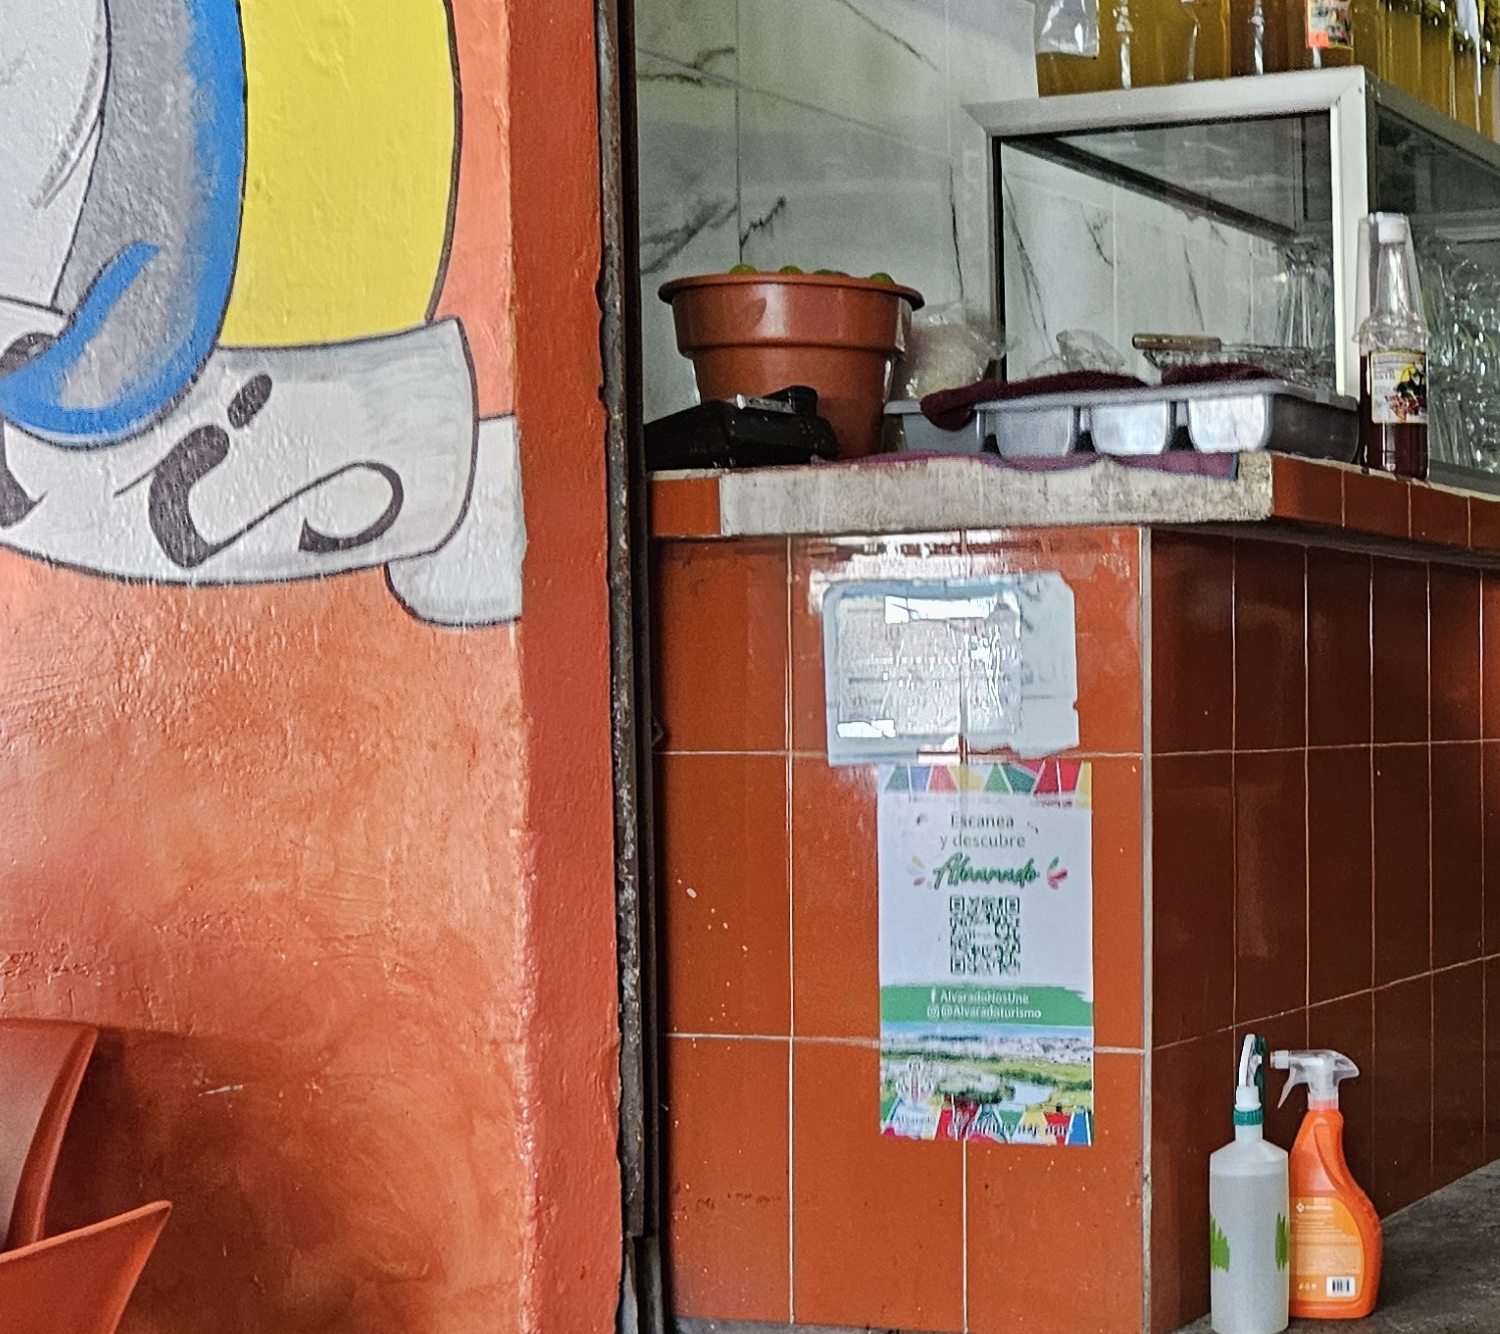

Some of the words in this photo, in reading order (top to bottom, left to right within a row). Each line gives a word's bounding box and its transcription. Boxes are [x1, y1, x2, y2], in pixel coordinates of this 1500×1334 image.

[950, 813, 1014, 828] Escanea
[940, 834, 948, 851] y
[952, 832, 1026, 848] descubre
